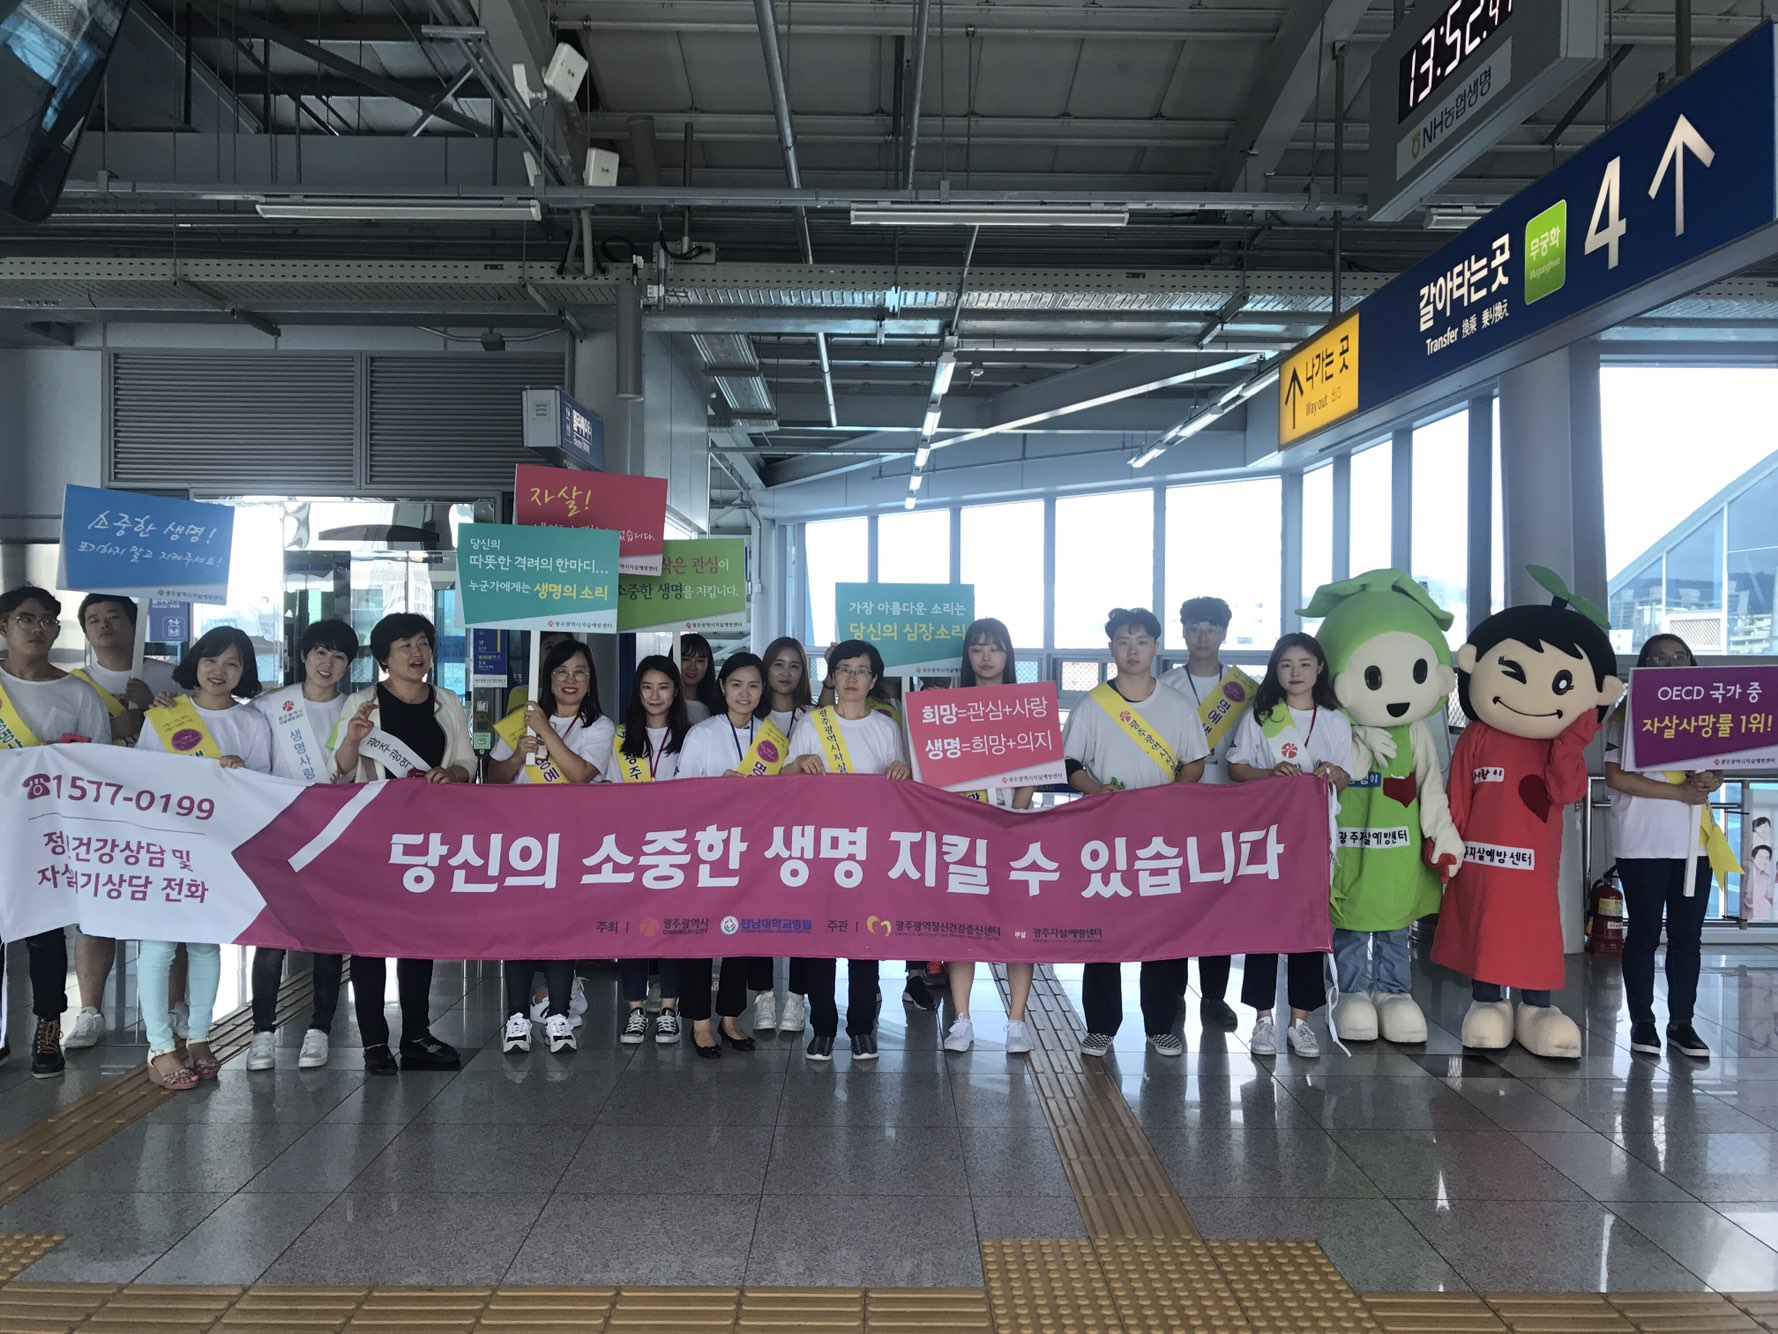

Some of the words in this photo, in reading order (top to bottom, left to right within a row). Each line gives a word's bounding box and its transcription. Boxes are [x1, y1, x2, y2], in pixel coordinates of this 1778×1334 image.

[1422, 65, 1492, 149] NH농협생명
[1584, 155, 1627, 271] 4
[1530, 225, 1561, 261] 무궁화
[1426, 326, 1459, 356] Transfer
[1305, 346, 1334, 390] 나가는
[1338, 334, 1350, 374] 곳
[1305, 400, 1317, 416] Way
[1317, 394, 1328, 410] out
[529, 486, 593, 517] 자살!
[87, 510, 157, 537] 소중한
[163, 522, 218, 544] 생명!
[77, 541, 127, 556] 포기하지
[129, 545, 153, 563] 말고
[470, 538, 501, 551] 당신의
[469, 553, 512, 571] 따뜻한
[514, 555, 553, 572] 격려의
[555, 557, 609, 574] 한마디...
[691, 555, 730, 575] 관심이
[468, 579, 532, 594] 누군가에게는
[533, 581, 577, 600] 생명의
[579, 585, 609, 602] 소리
[657, 582, 694, 601] 생명을
[696, 584, 739, 599] 지킵니다.
[848, 601, 875, 615] 가장
[877, 601, 927, 616] 아름다운
[929, 601, 967, 616] 소리는
[849, 622, 898, 641] 당신의
[902, 622, 967, 641] 심장소리
[1657, 686, 1705, 701] OECD
[1709, 682, 1743, 704] 국가
[1746, 682, 1762, 703] 중
[922, 696, 1048, 726] 희망=관심+사랑
[1642, 713, 1734, 739] 자살사망률
[1739, 712, 1773, 734] 1위!
[290, 728, 316, 780] 생명사랑
[924, 730, 1053, 761] 생명=희망+의지
[52, 774, 215, 820] 1577-0199
[43, 830, 166, 869] 정건강상담
[172, 849, 194, 872] 및
[387, 831, 561, 894] 당신의
[579, 823, 750, 890] 소중한
[763, 824, 869, 889] 생명
[887, 830, 990, 895] 지킬
[1008, 840, 1061, 897] 수
[1080, 823, 1286, 899] 있습니다
[161, 877, 209, 904] 전화
[596, 920, 619, 933] 주최
[663, 918, 709, 929] 광주광역시
[740, 917, 813, 930] 전남대학교병원
[827, 919, 849, 932] 주관
[1032, 927, 1104, 939] 광주자살예방센터
